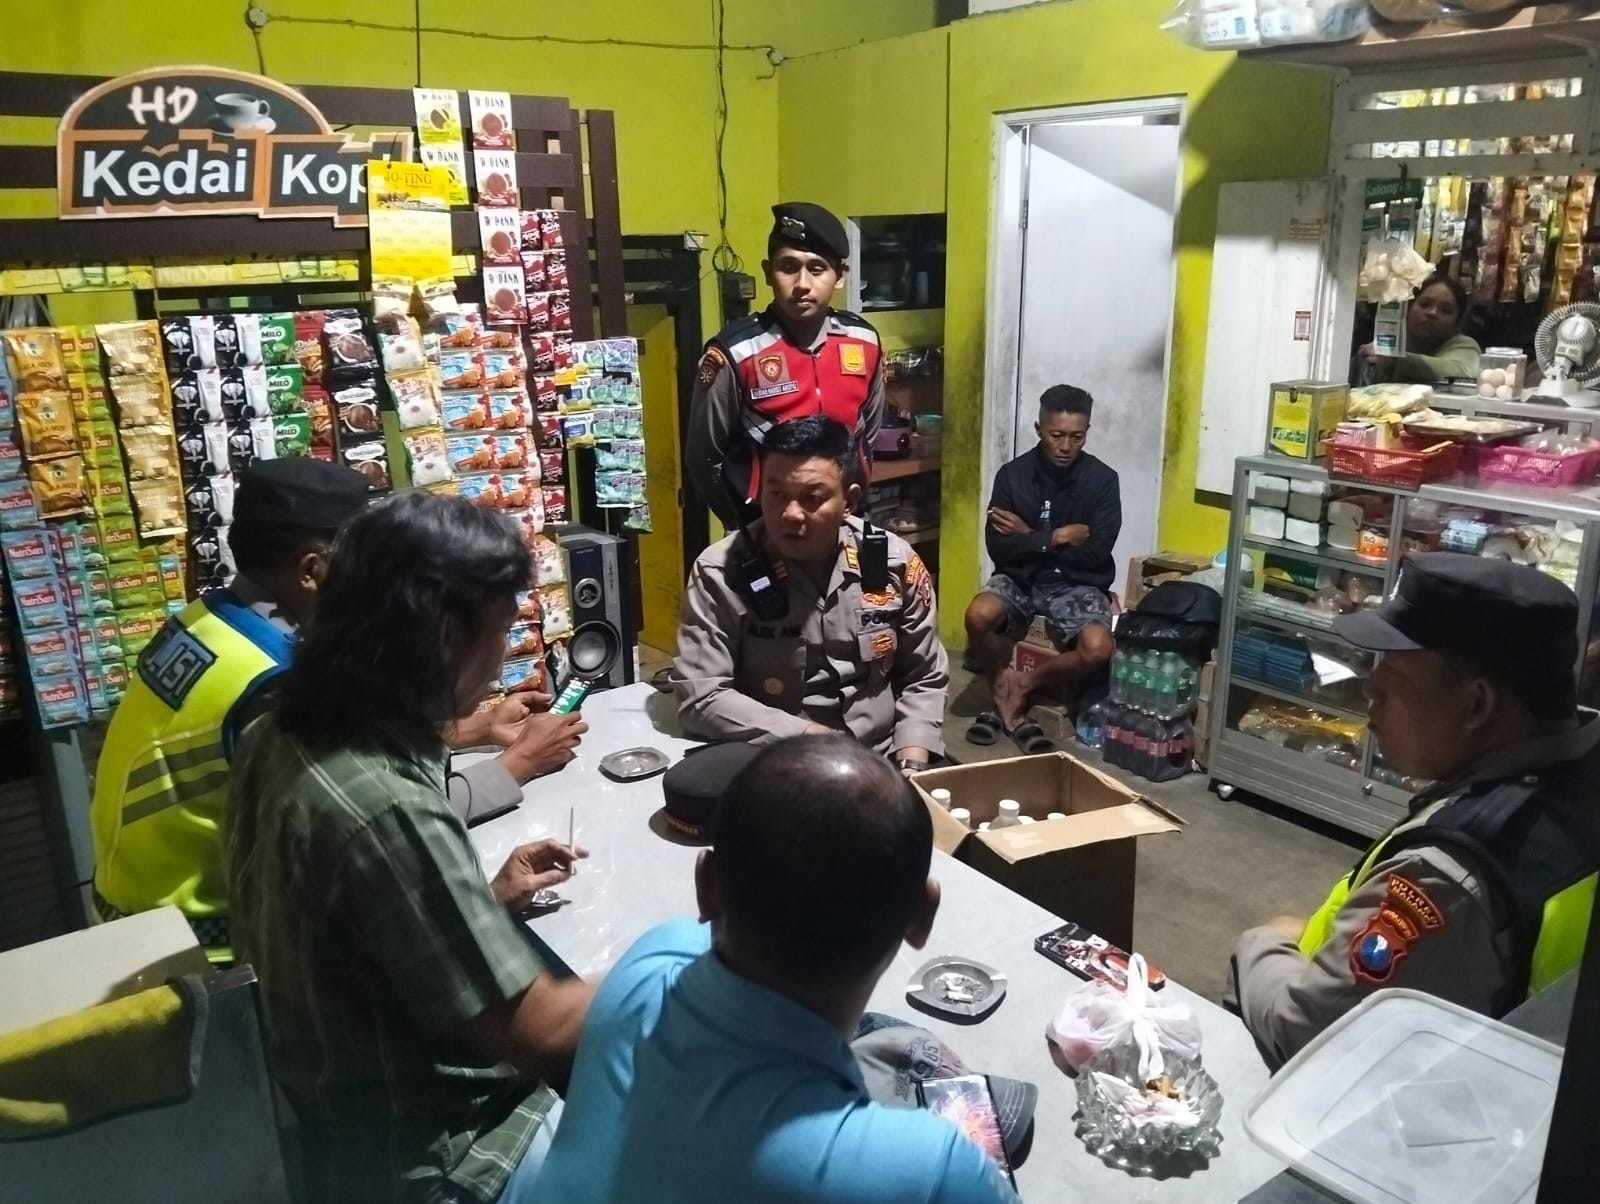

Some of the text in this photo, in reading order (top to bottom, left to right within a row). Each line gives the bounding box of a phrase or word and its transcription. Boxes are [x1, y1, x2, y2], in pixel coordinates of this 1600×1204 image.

[127, 85, 198, 126] HD
[81, 148, 391, 203] Kedai Kop
[384, 171, 432, 185] JO-TING
[261, 330, 282, 338] MILO
[269, 380, 290, 388] MILO
[276, 428, 297, 436] MILO
